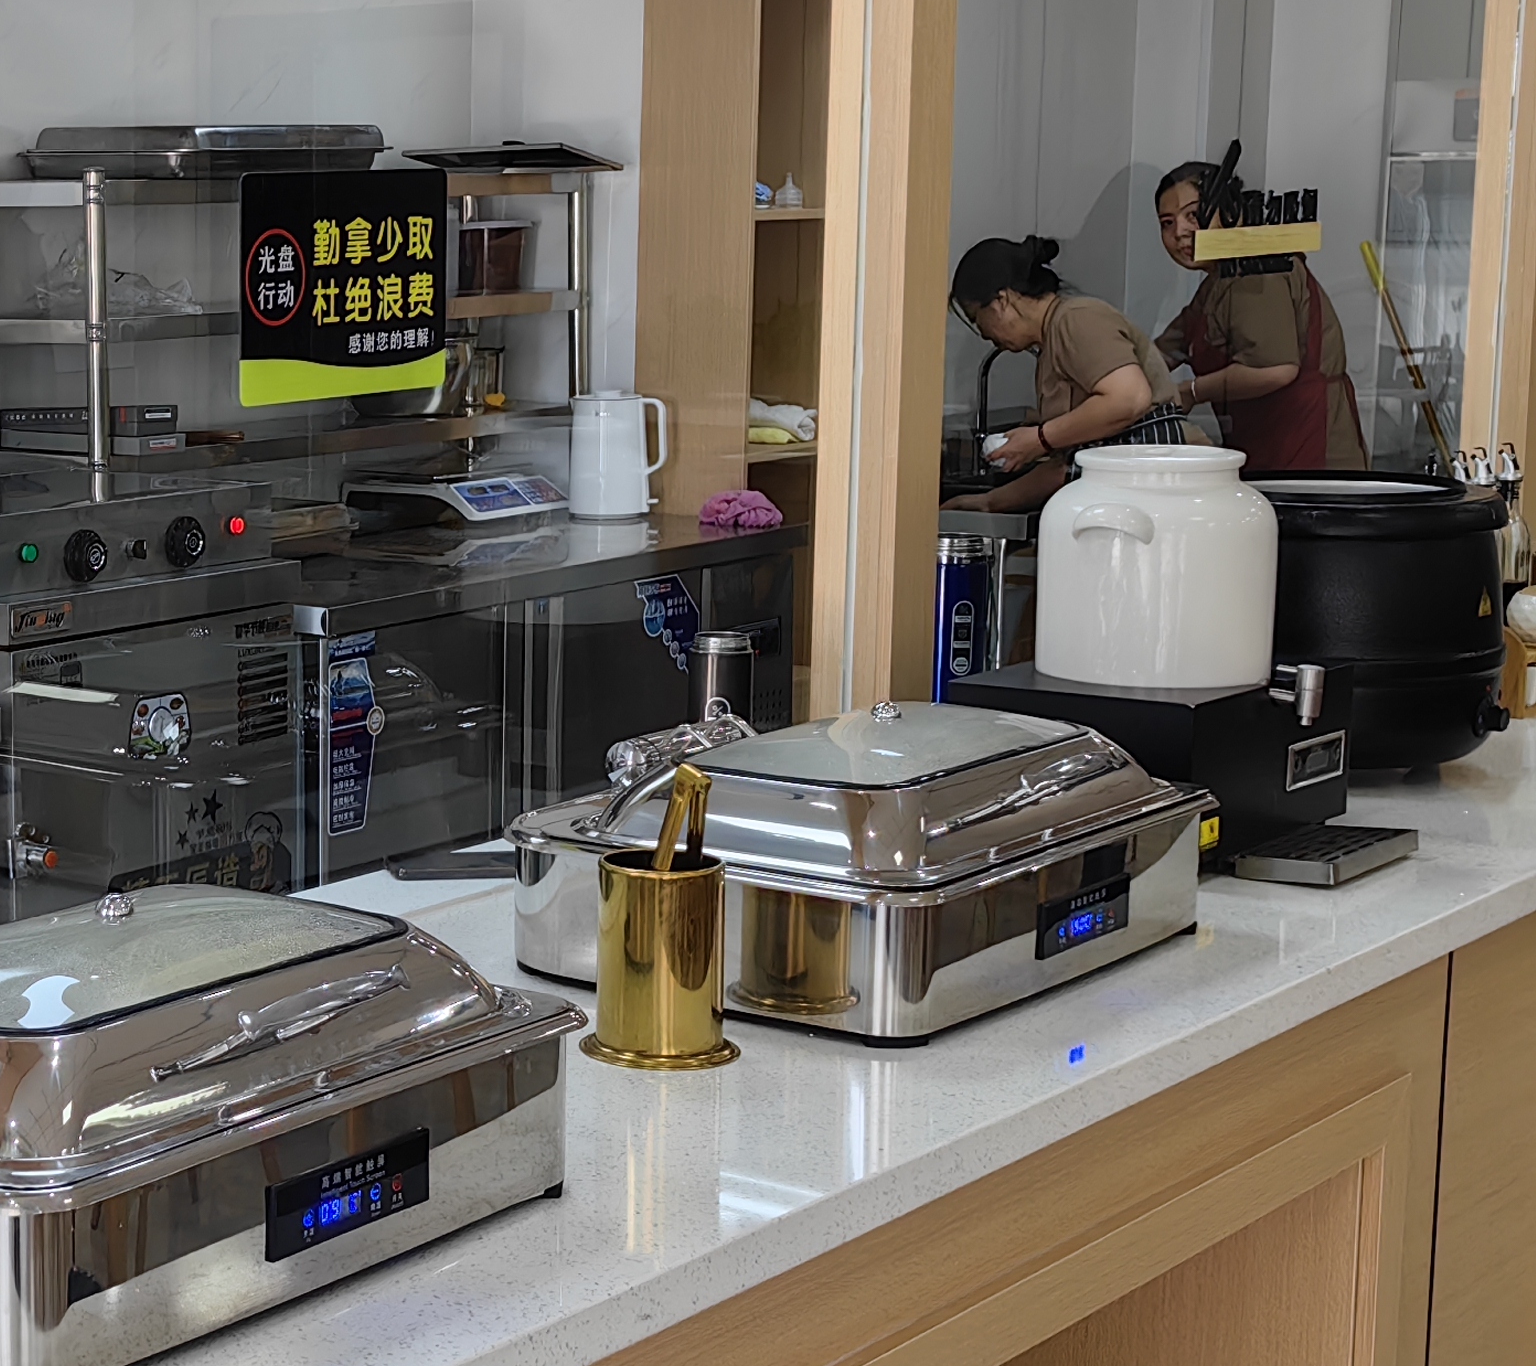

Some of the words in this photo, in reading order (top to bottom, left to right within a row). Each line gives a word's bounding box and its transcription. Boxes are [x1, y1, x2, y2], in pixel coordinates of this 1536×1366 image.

[258, 244, 295, 275] 光盘
[313, 215, 434, 267] 勤拿少取
[257, 279, 295, 311] 行动
[312, 271, 435, 327] 杜绝浪费
